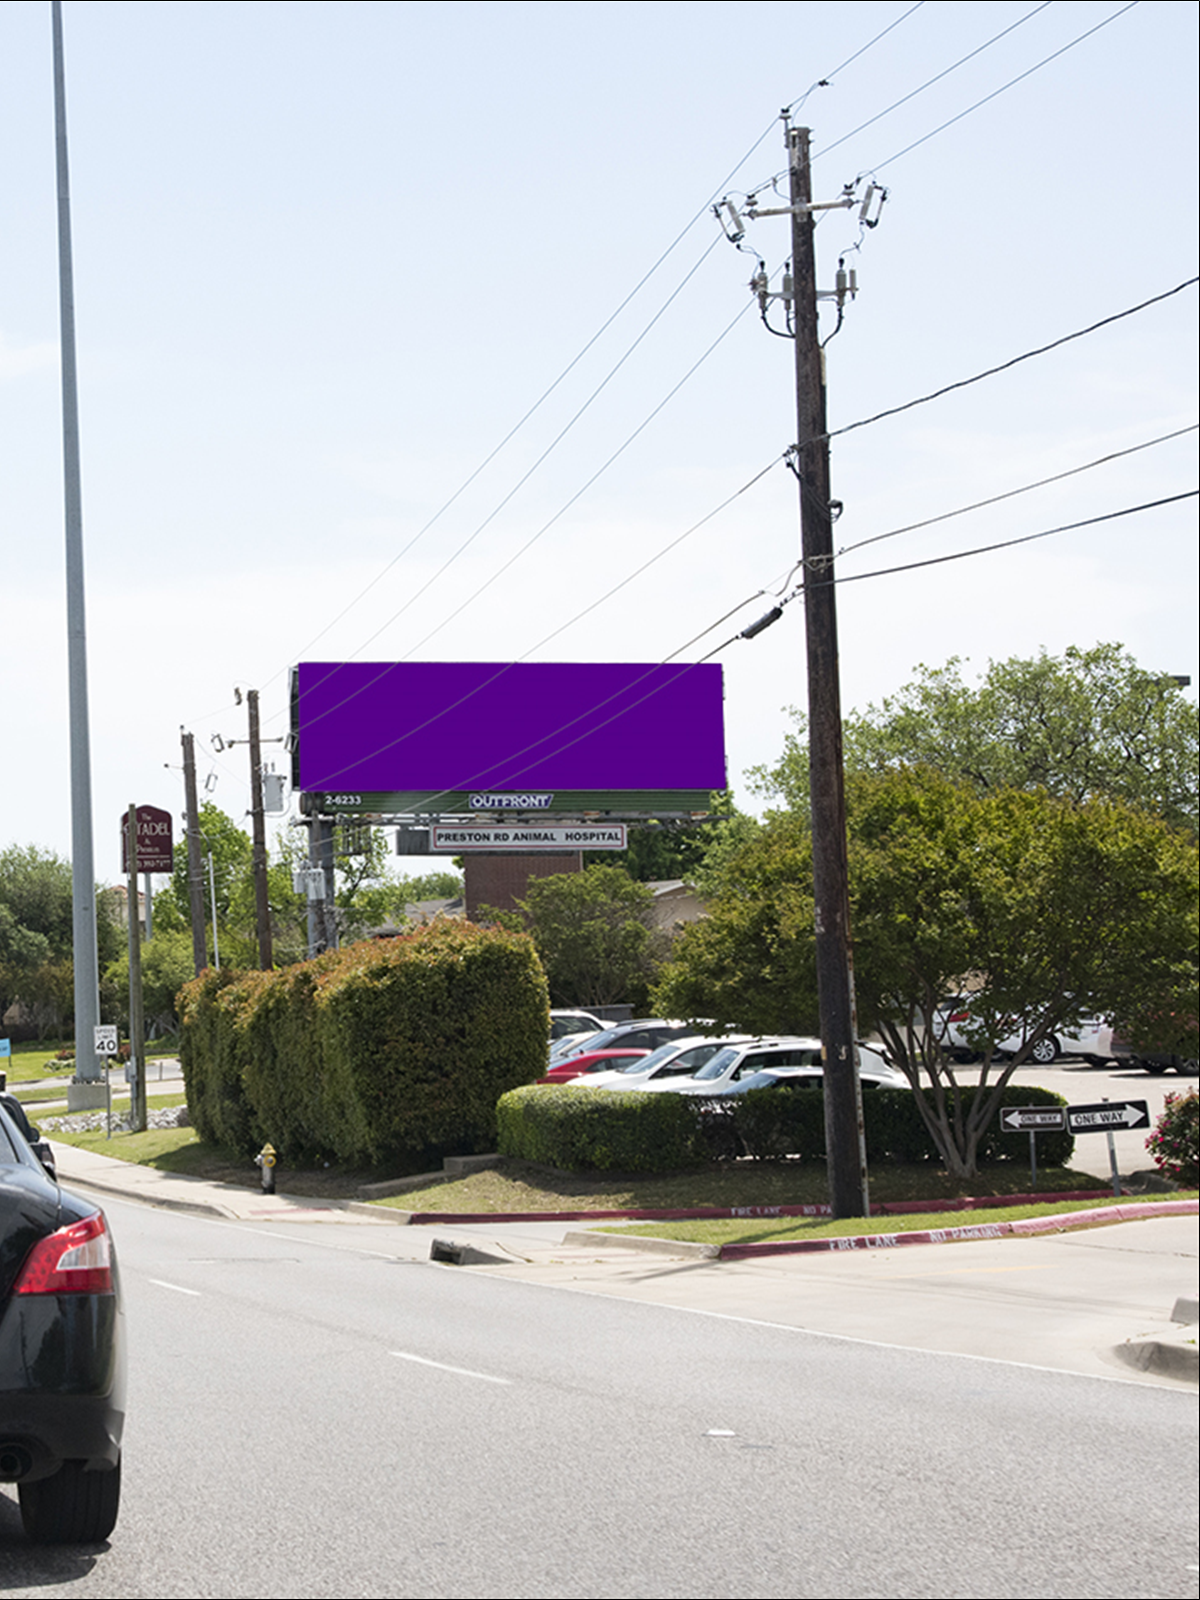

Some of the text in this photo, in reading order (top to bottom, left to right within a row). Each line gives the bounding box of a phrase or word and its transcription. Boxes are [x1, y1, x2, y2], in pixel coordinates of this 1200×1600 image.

[325, 795, 361, 805] 2-6233
[471, 795, 550, 807] OUTFRONT
[123, 822, 171, 836] CTADEL
[437, 832, 622, 842] PRESTON RD ANIMAL HOSPITAL
[96, 1040, 116, 1051] 40
[1020, 1114, 1058, 1123] ONE WAY
[1074, 1112, 1124, 1125] ONE WAY
[730, 1207, 753, 1216] FIRE
[756, 1206, 781, 1215] LANE
[803, 1206, 817, 1214] NO
[828, 1226, 1003, 1251] FIRE LANE NO PARKING
